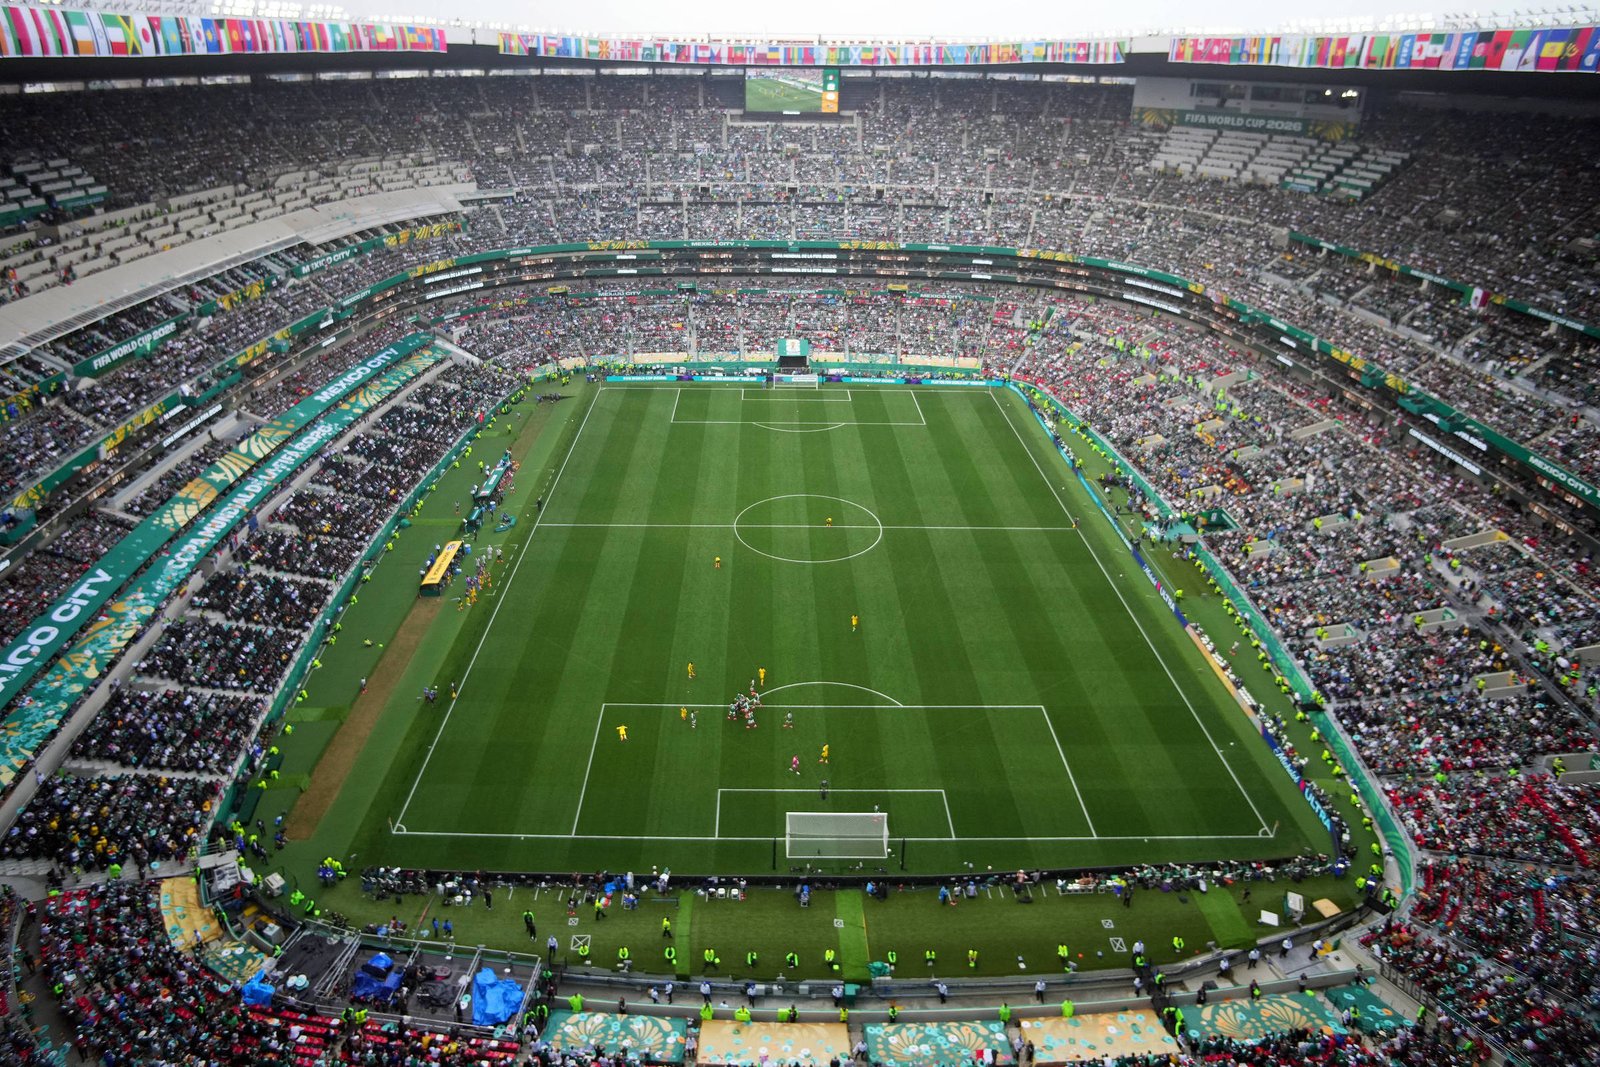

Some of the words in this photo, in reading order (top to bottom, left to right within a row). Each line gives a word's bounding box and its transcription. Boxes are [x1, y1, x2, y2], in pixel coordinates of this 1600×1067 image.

[1184, 113, 1208, 124] FIFA
[1207, 115, 1243, 127] WORLD
[1245, 118, 1266, 129] CUP
[1266, 119, 1302, 131] 2026
[333, 250, 351, 262] CITY
[93, 353, 112, 370] FIFA
[110, 341, 138, 361] WORLD
[137, 334, 153, 347] CUP
[152, 322, 176, 341] 2026
[314, 366, 373, 402] MEXICO
[366, 347, 399, 369] CITY
[1529, 456, 1567, 481] MEXICO
[1567, 478, 1592, 495] CITY
[198, 490, 257, 538] MUNDIAL
[51, 568, 113, 623] CITY
[1159, 586, 1175, 613] ULTRA
[1304, 787, 1332, 832] ULTRA
